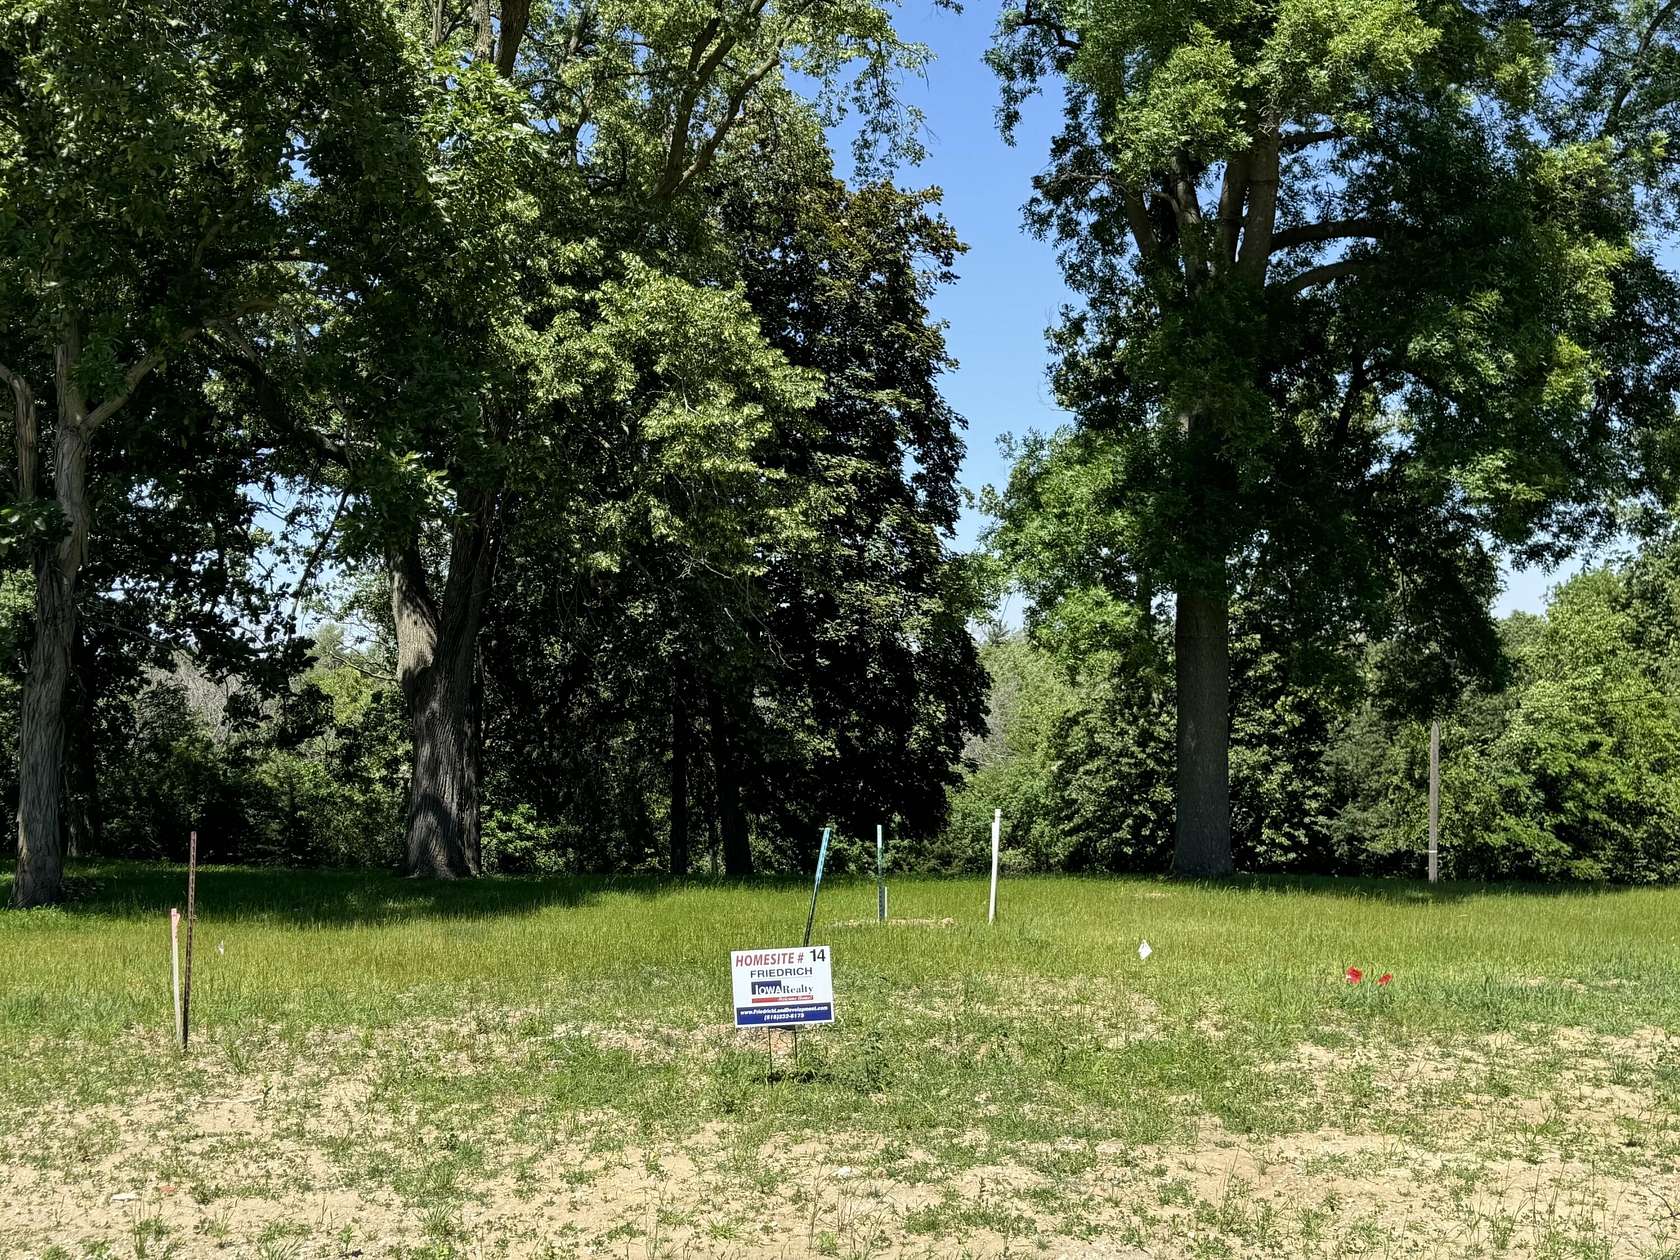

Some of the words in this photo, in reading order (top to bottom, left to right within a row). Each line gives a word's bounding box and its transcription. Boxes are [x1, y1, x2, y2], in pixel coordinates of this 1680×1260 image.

[736, 952, 794, 967] HOMESITE
[797, 952, 804, 964] #
[810, 948, 826, 962] 14
[750, 967, 813, 978] FRIEDRICH
